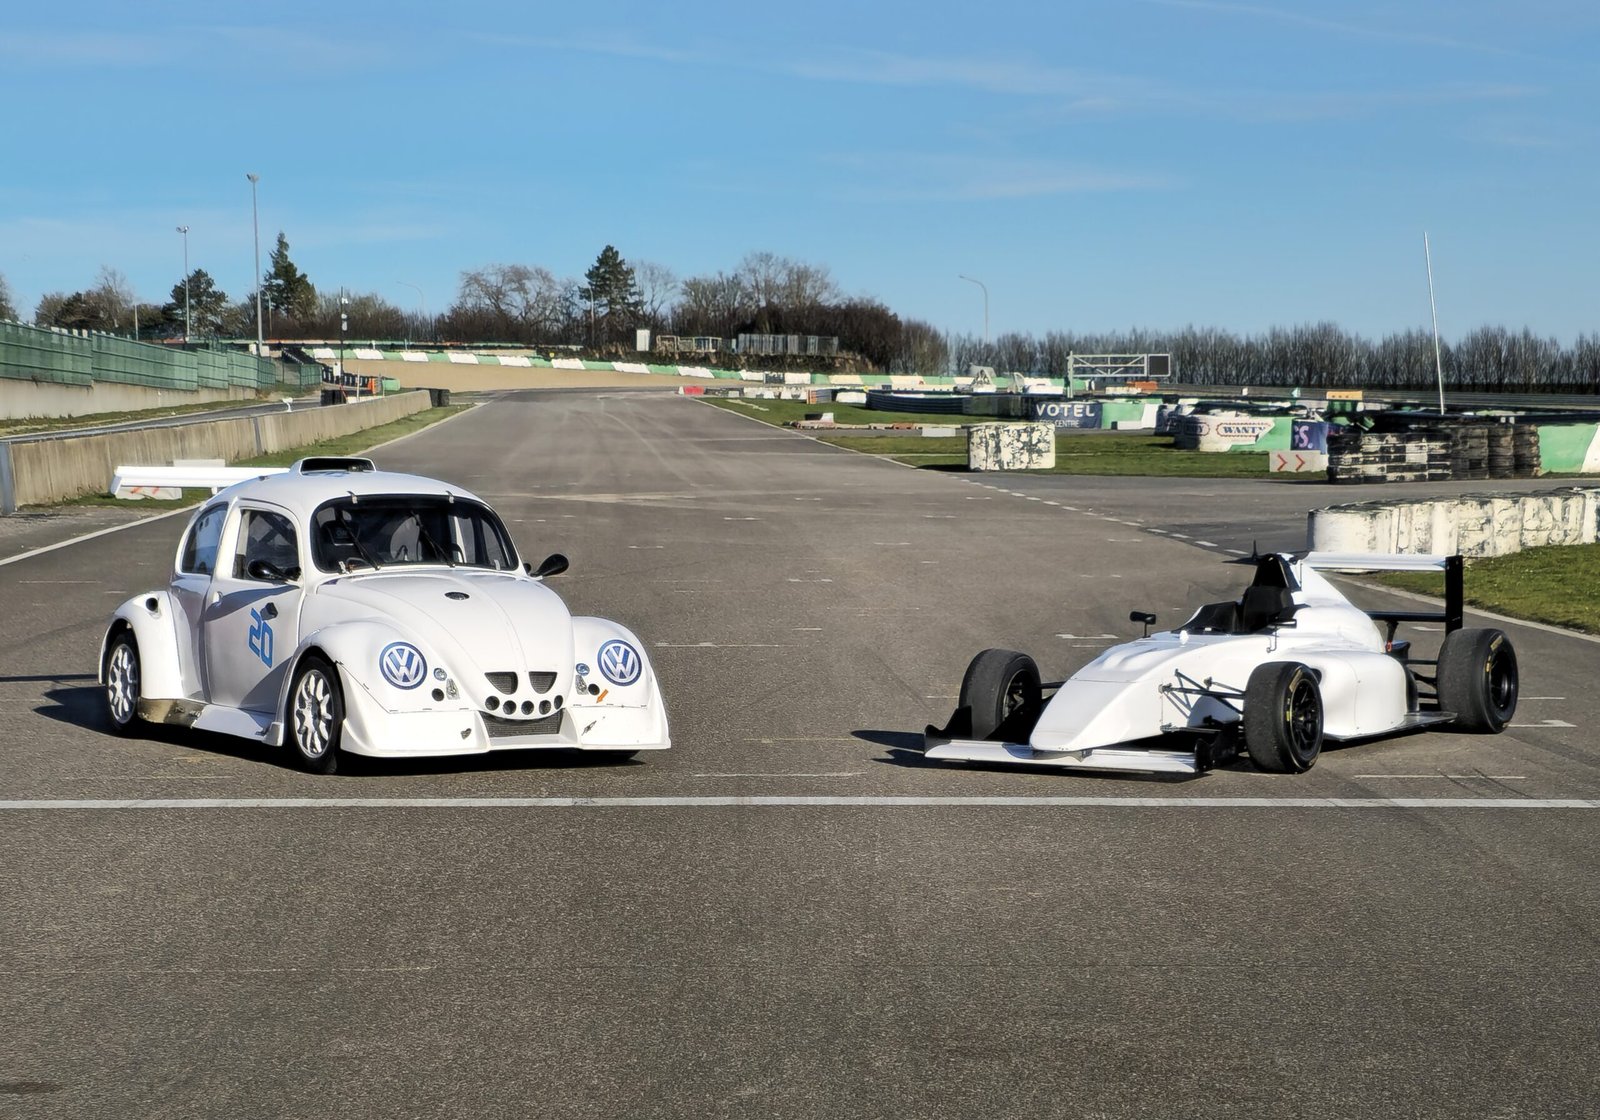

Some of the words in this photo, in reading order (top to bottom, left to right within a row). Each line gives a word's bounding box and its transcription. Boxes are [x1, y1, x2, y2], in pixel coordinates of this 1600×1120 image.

[1036, 404, 1095, 417] VOTEL
[382, 644, 425, 687] VW
[600, 642, 640, 684] VW
